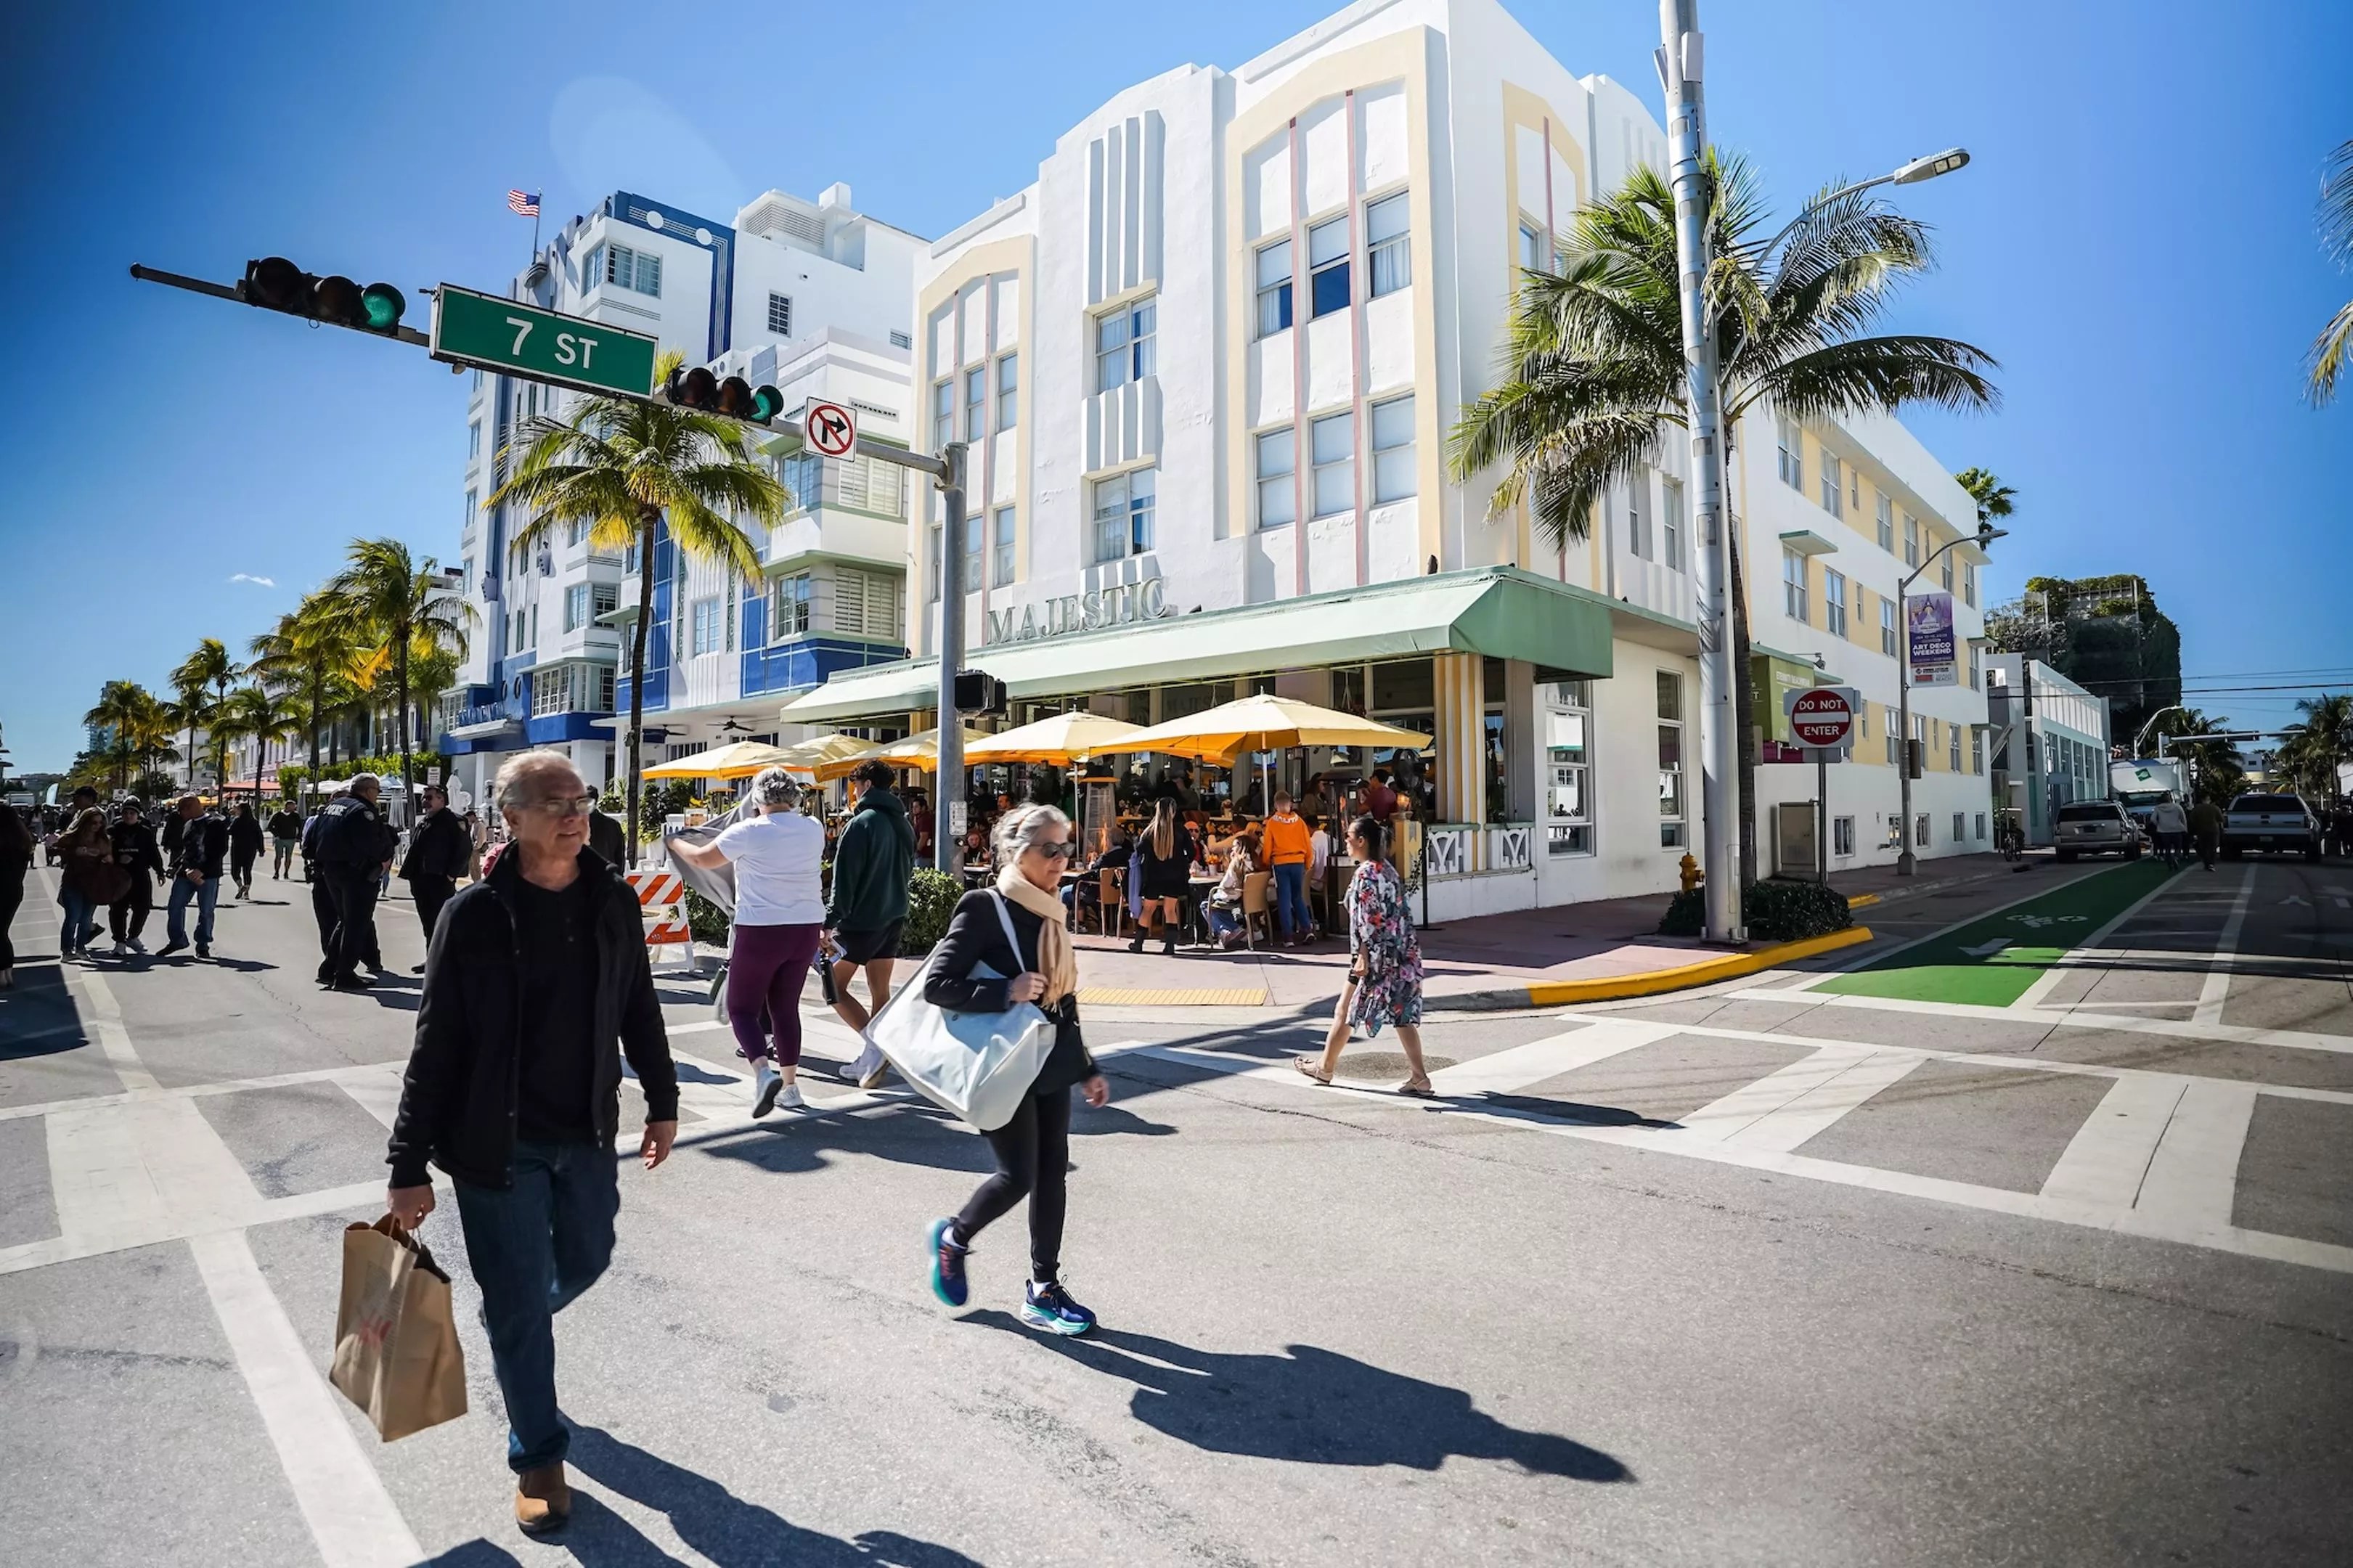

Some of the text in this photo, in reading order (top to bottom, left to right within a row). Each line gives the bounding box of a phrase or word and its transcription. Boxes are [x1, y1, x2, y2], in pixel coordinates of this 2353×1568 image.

[506, 317, 598, 369] 7 ST
[987, 576, 1167, 645] MAJESTIC
[1799, 699, 1843, 711] DO NOT
[1804, 725, 1840, 737] ENTER
